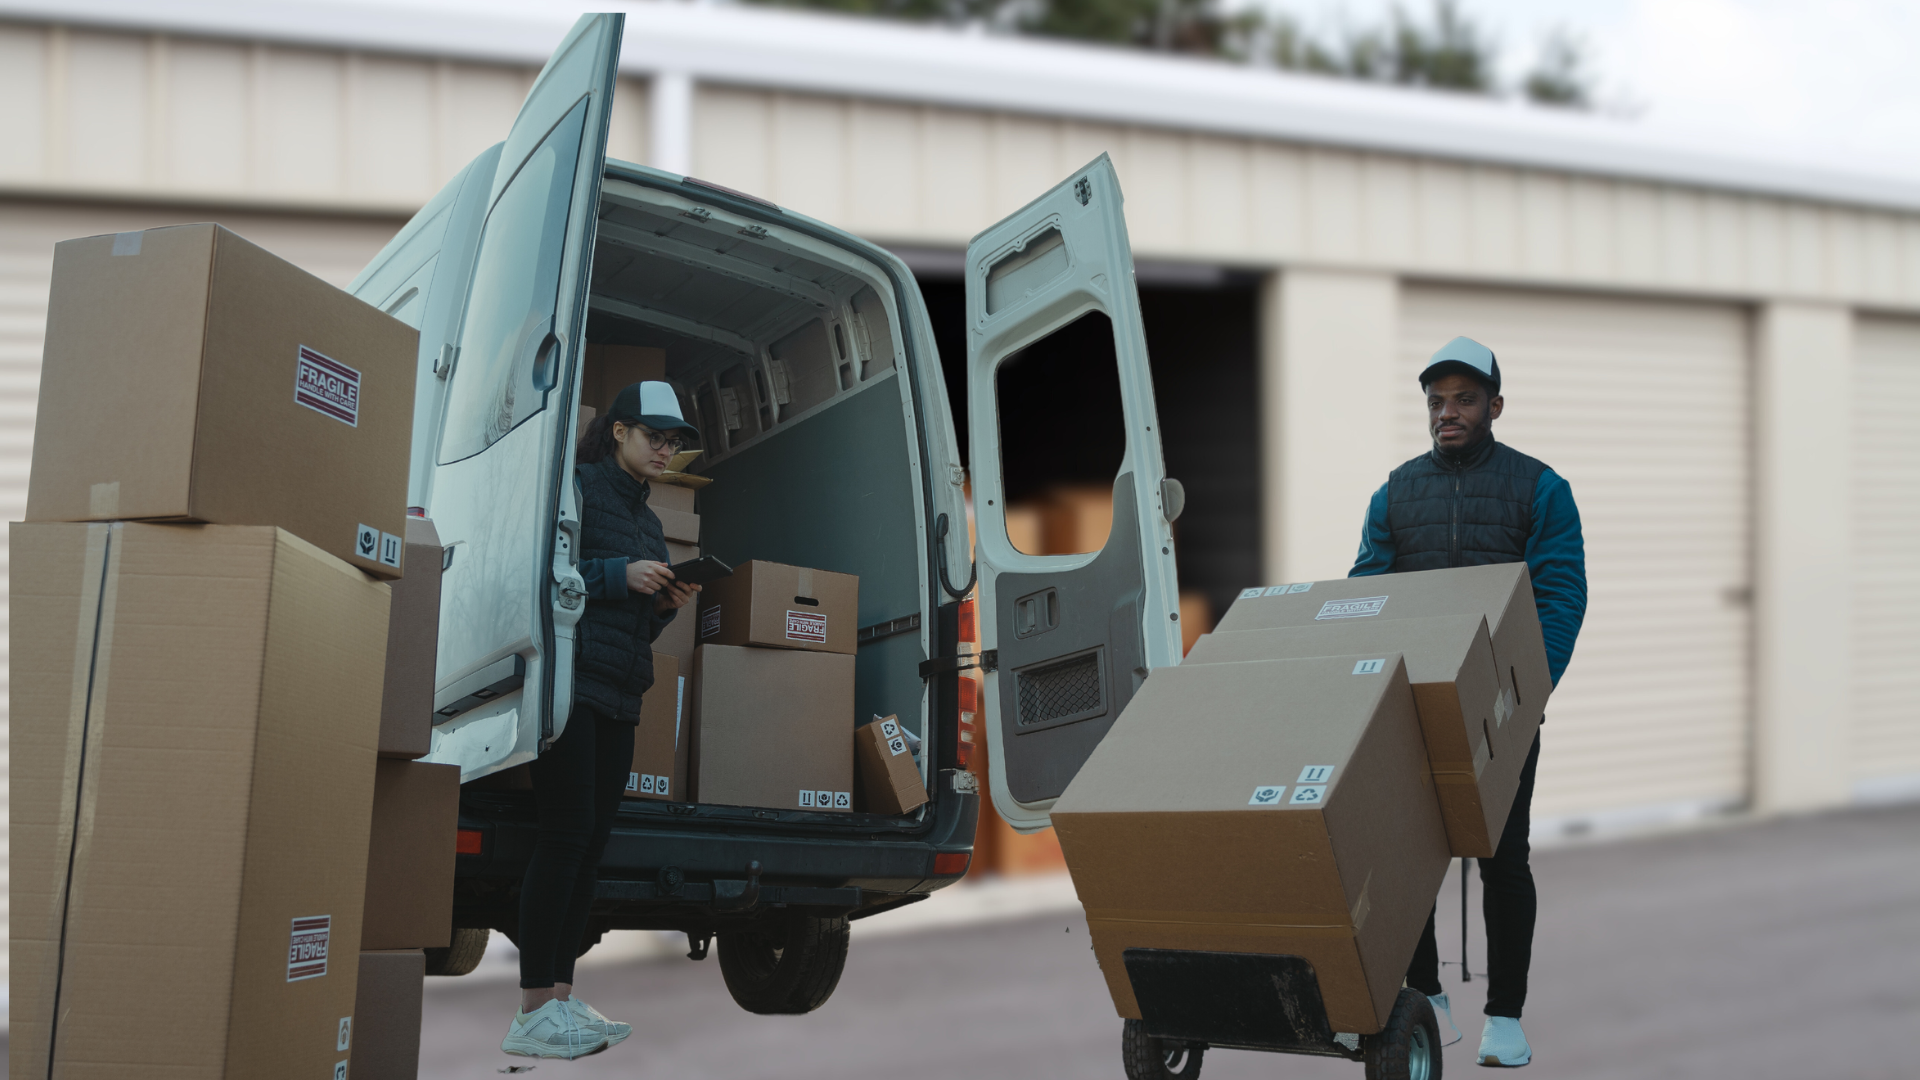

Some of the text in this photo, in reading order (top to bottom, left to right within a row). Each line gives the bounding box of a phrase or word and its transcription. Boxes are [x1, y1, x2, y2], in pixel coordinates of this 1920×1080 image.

[300, 364, 357, 403] FRAGILE
[299, 380, 356, 410] HANDLE WITH CARE
[1323, 601, 1382, 612] FRAGILE
[788, 622, 825, 634] FRAGILE
[291, 940, 328, 961] FRAGILE
